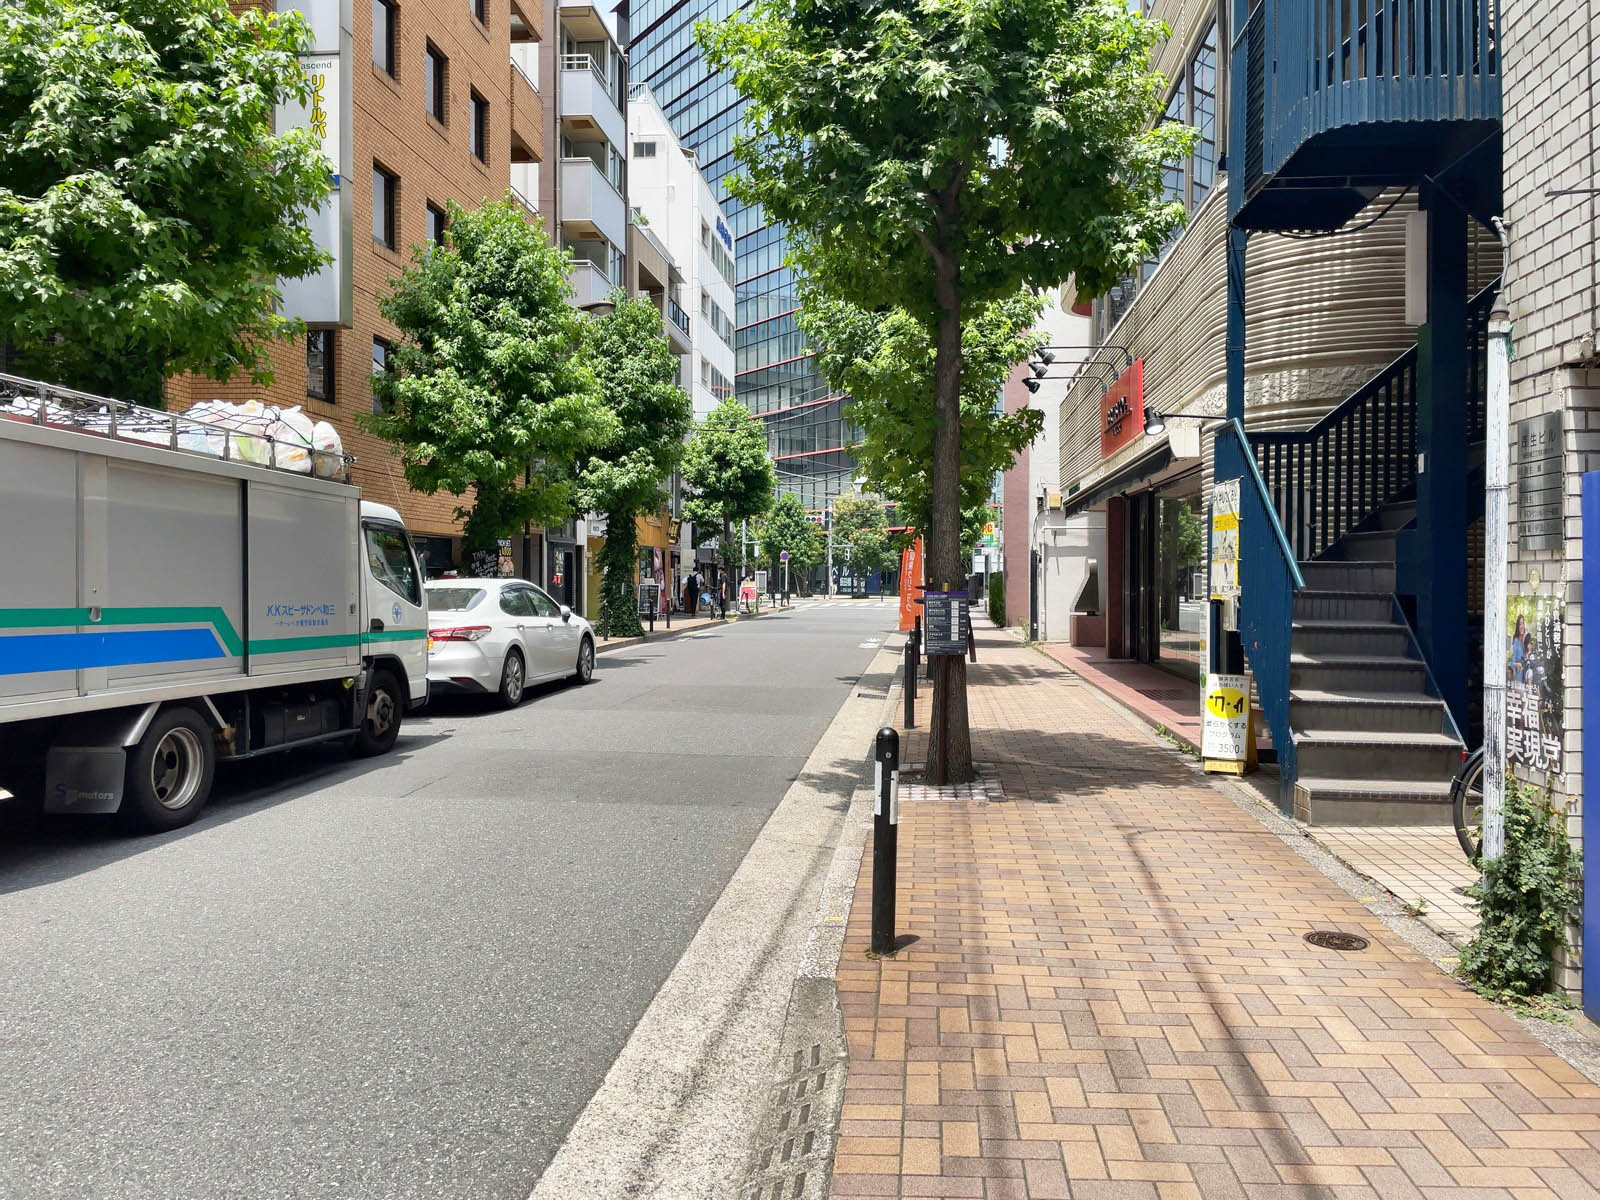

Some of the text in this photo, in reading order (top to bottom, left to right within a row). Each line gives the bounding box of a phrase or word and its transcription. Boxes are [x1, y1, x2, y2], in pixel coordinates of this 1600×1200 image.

[301, 61, 332, 70] ascend
[1507, 690, 1540, 731] 幸福
[1507, 726, 1562, 773] 実現党
